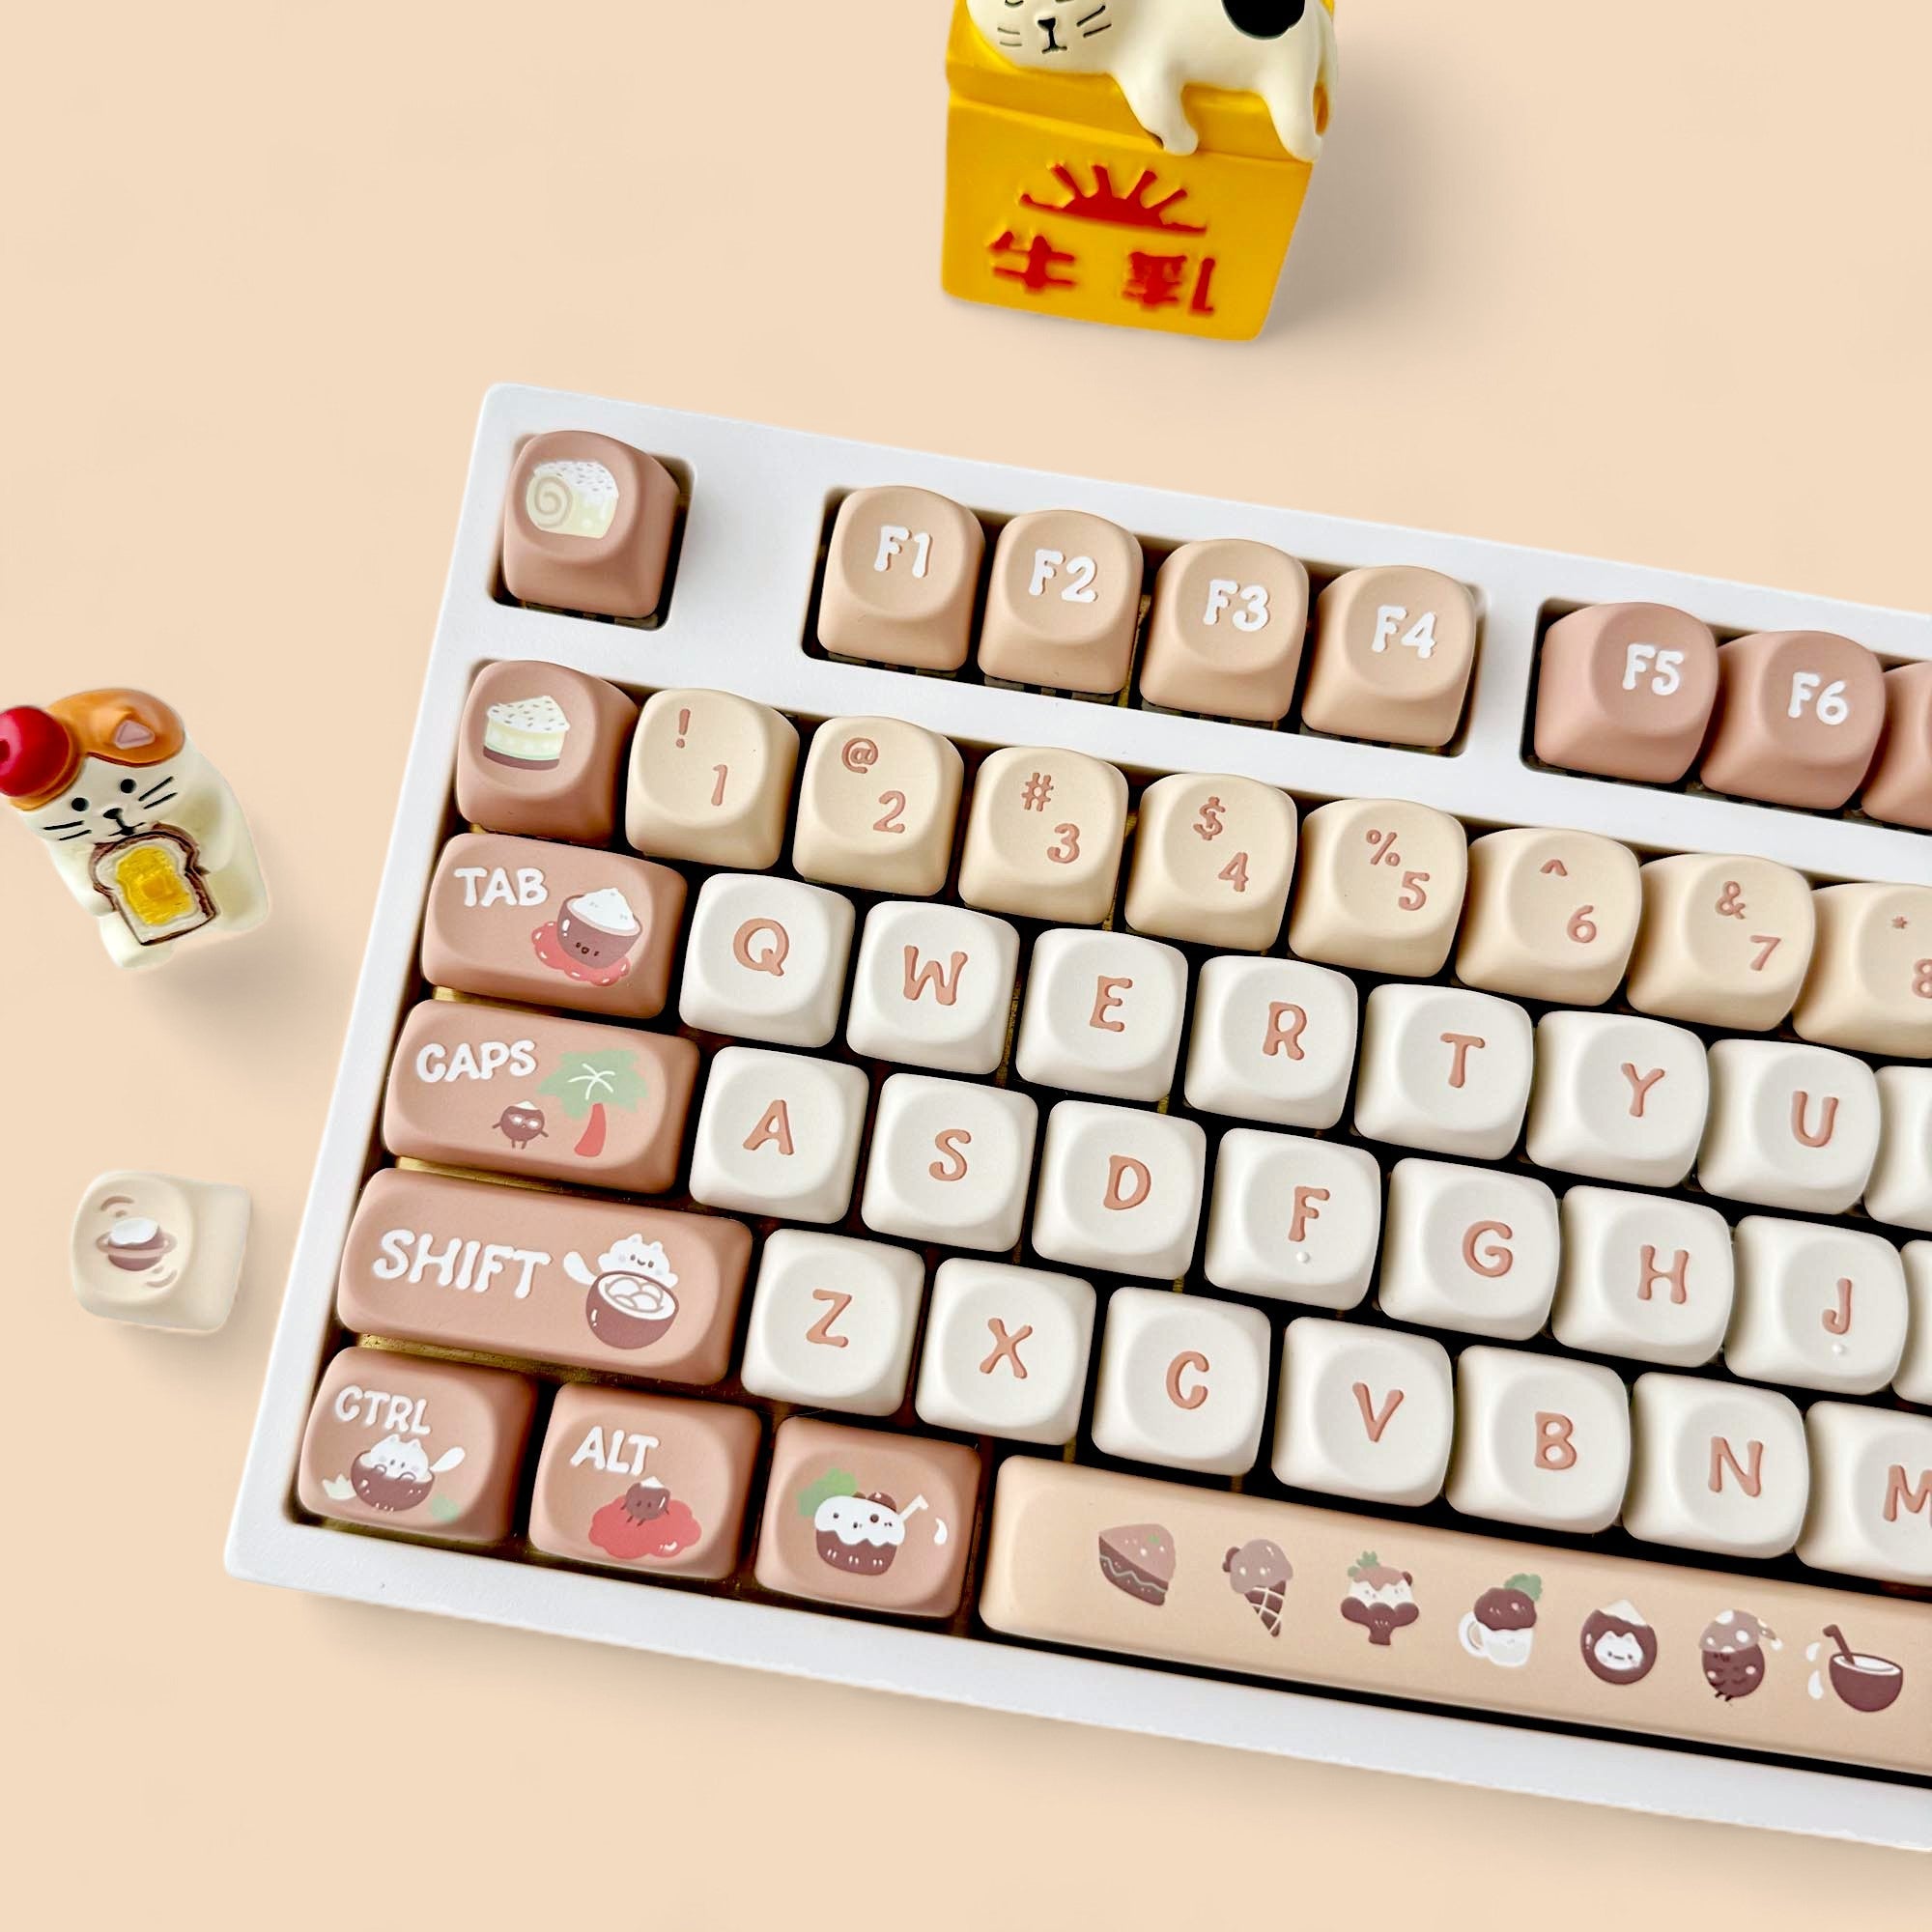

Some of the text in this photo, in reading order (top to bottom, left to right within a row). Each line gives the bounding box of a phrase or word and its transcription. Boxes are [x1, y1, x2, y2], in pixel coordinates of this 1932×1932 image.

[874, 525, 932, 580] F1
[1028, 549, 1096, 604] F2
[1203, 579, 1268, 632] F3
[1372, 605, 1435, 659] F4
[1622, 642, 1685, 696] F5
[1787, 671, 1849, 725] F6
[676, 709, 691, 747] !
[841, 738, 879, 774] @
[711, 764, 728, 805] 1
[874, 791, 906, 833] 2
[1022, 772, 1052, 812] #
[1047, 823, 1079, 865] 3
[1193, 796, 1227, 840] $
[1218, 852, 1250, 893] 4
[1366, 829, 1402, 867] %
[454, 867, 548, 907] TAB
[1398, 870, 1431, 911] 5
[1715, 880, 1747, 920] &
[731, 918, 790, 978] Q
[1567, 905, 1599, 945] 6
[1749, 934, 1782, 971] 7
[902, 945, 970, 1006] W
[1089, 975, 1134, 1034] E
[1263, 1000, 1308, 1062] R
[416, 1039, 536, 1083] CAPS
[1440, 1032, 1486, 1089] T
[1622, 1062, 1666, 1120] Y
[742, 1098, 795, 1155] A
[1792, 1090, 1840, 1149] U
[928, 1127, 973, 1182] S
[1102, 1153, 1152, 1211] D
[1288, 1185, 1330, 1243] F
[373, 1229, 552, 1299] SHIFT
[1462, 1220, 1515, 1278] G
[1638, 1244, 1690, 1306] H
[806, 1288, 852, 1350] Z
[1823, 1277, 1854, 1335] J
[979, 1317, 1034, 1380] X
[1165, 1350, 1211, 1411] C
[335, 1386, 431, 1435] CTRL
[1352, 1381, 1406, 1444] V
[570, 1426, 659, 1477] ALT
[1534, 1410, 1578, 1472] B
[1710, 1436, 1766, 1499] N
[1883, 1464, 1932, 1523] M
